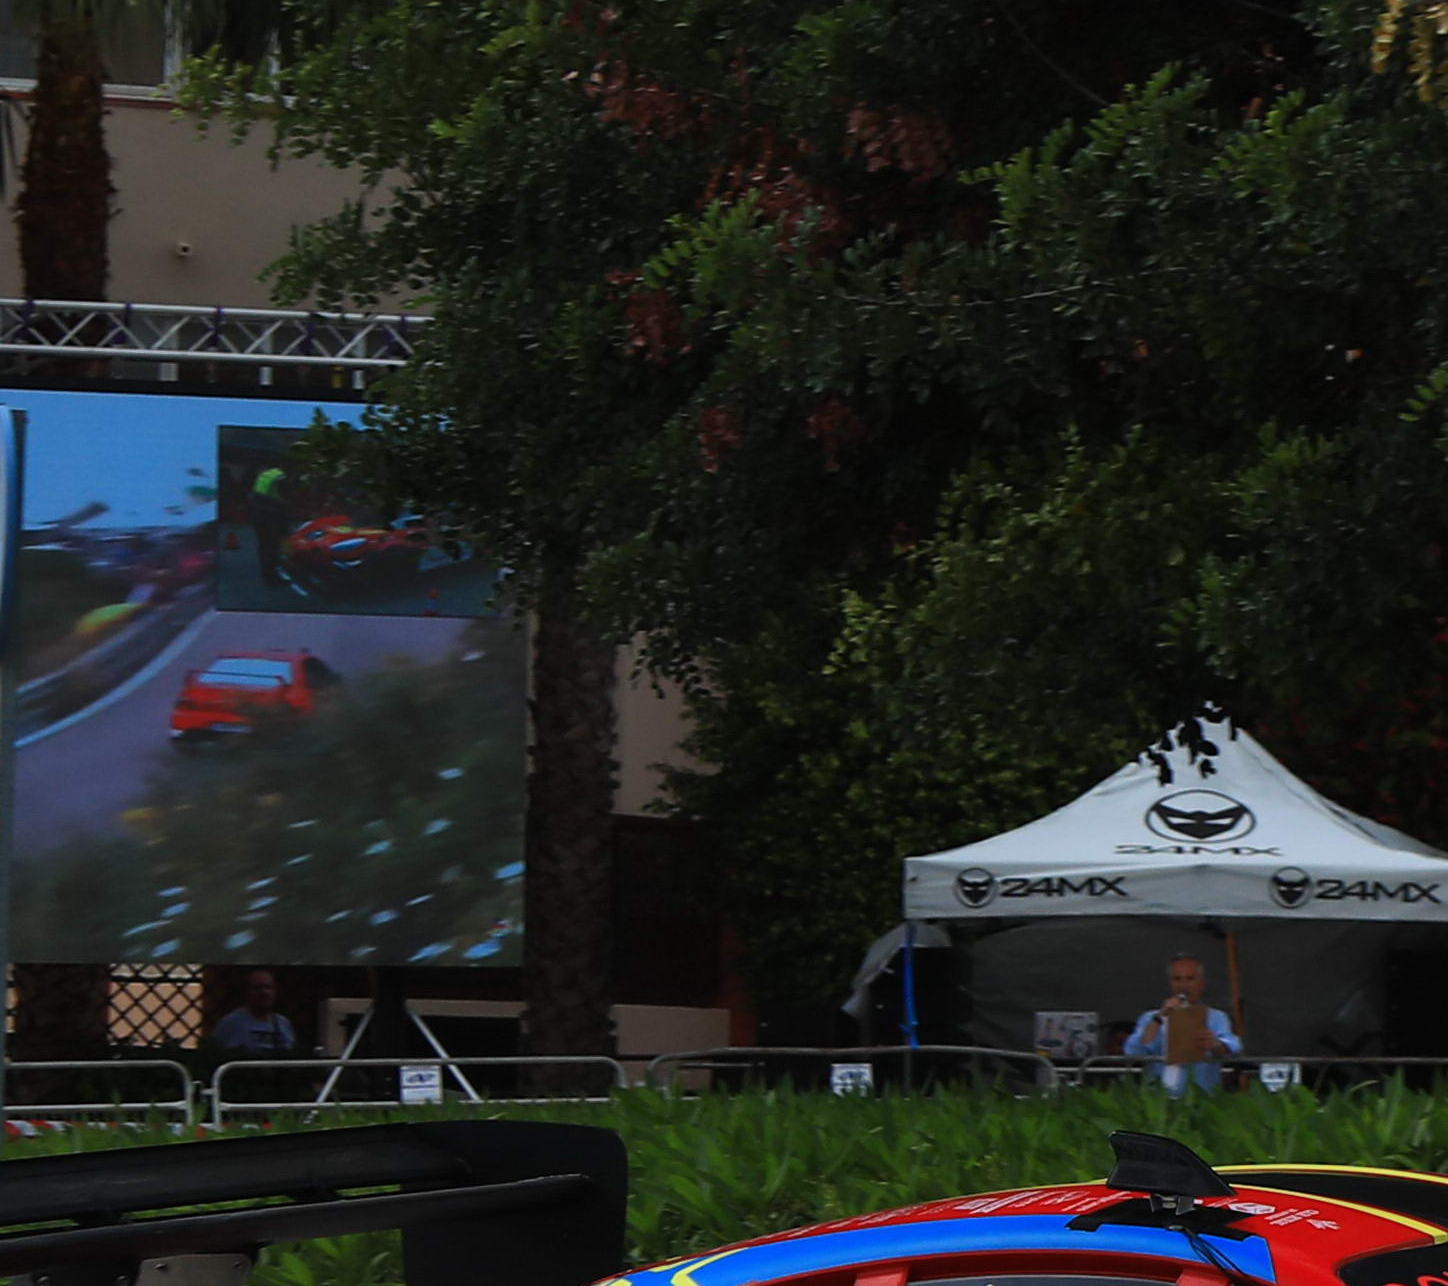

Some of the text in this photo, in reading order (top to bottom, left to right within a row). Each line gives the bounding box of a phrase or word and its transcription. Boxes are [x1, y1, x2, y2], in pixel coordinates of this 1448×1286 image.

[1113, 843, 1284, 857] 24MX
[998, 875, 1129, 899] 24MX
[1314, 878, 1442, 905] 24MX
